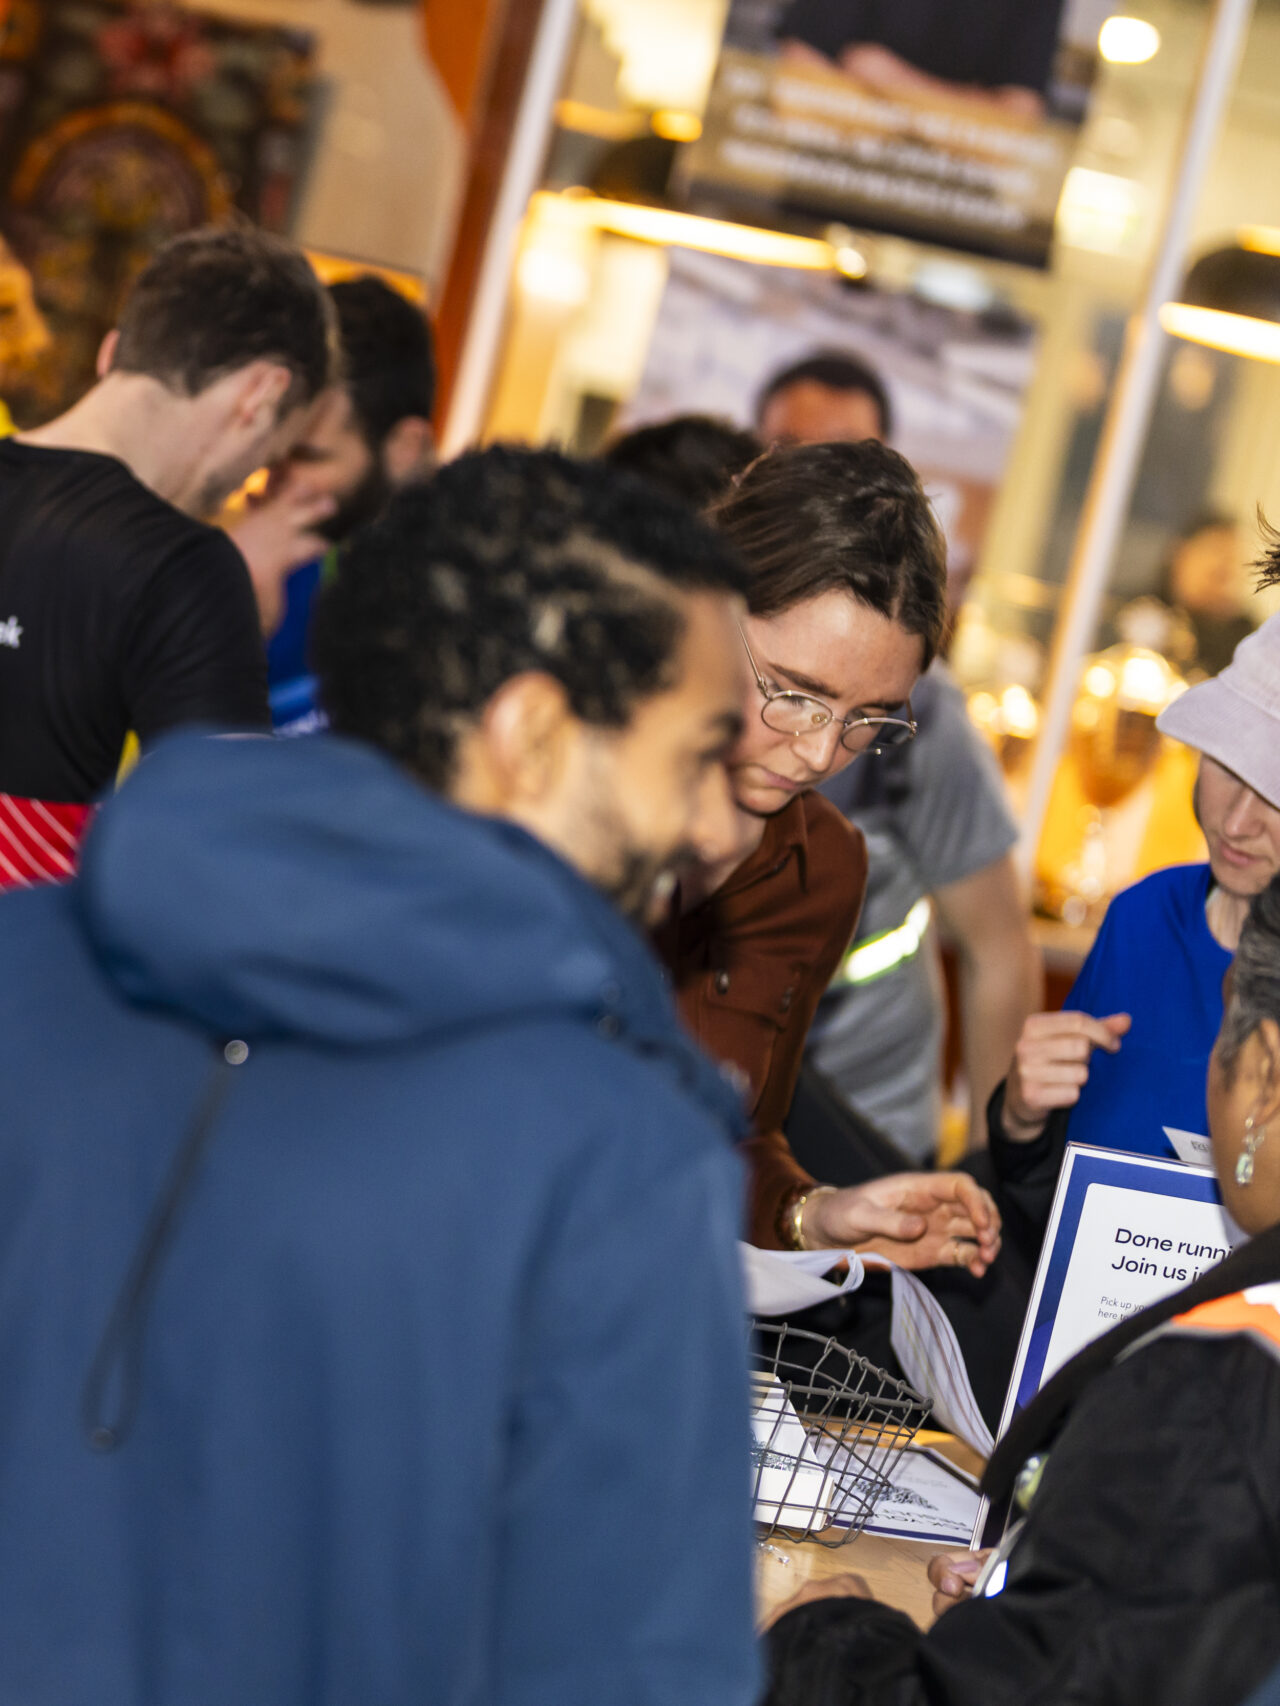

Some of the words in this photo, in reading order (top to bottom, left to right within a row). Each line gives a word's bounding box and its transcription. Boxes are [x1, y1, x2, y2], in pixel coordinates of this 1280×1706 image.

[1114, 1227, 1173, 1252] Done
[1111, 1256, 1158, 1277] Join
[1162, 1266, 1187, 1281] us
[1101, 1296, 1118, 1307] Pick
[1120, 1302, 1131, 1311] up
[1098, 1308, 1118, 1320] here
